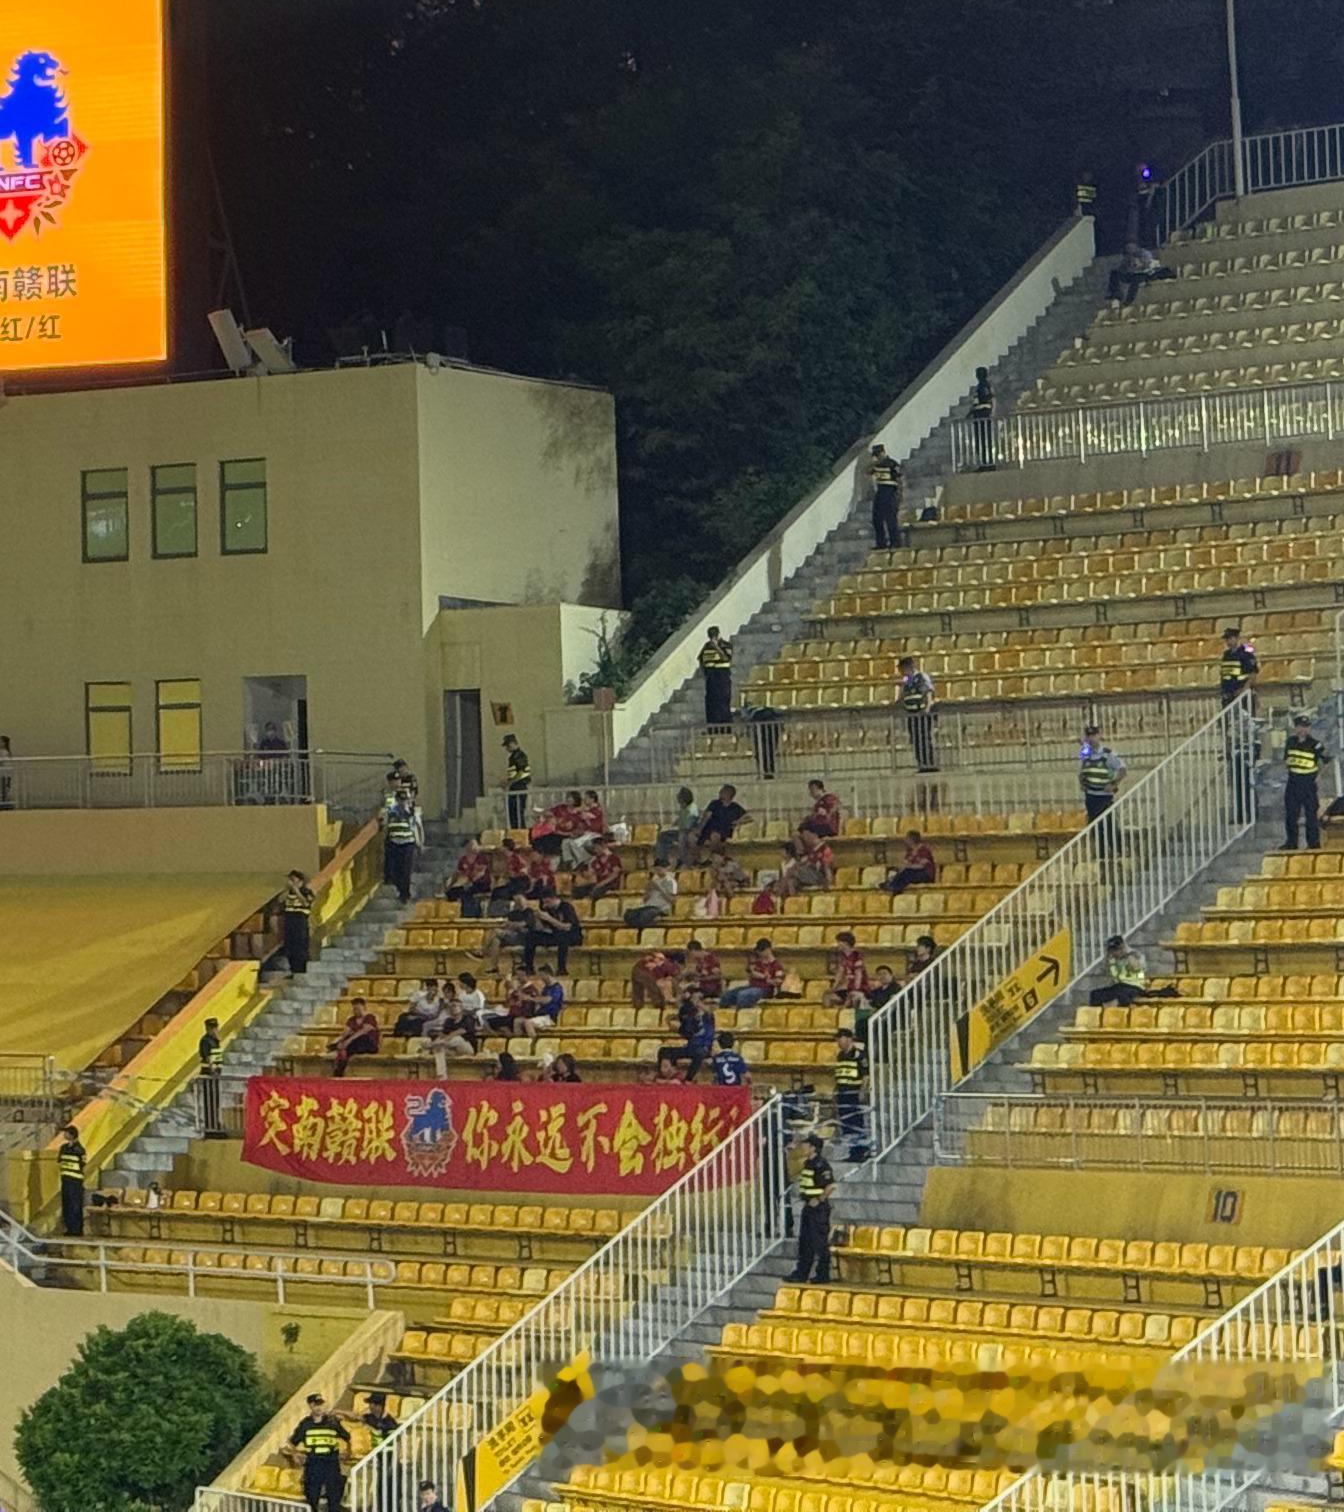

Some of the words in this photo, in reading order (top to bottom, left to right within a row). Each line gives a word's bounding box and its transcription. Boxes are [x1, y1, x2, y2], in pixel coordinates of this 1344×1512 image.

[258, 1091, 397, 1166] 定南赣联
[1213, 1190, 1238, 1223] 10
